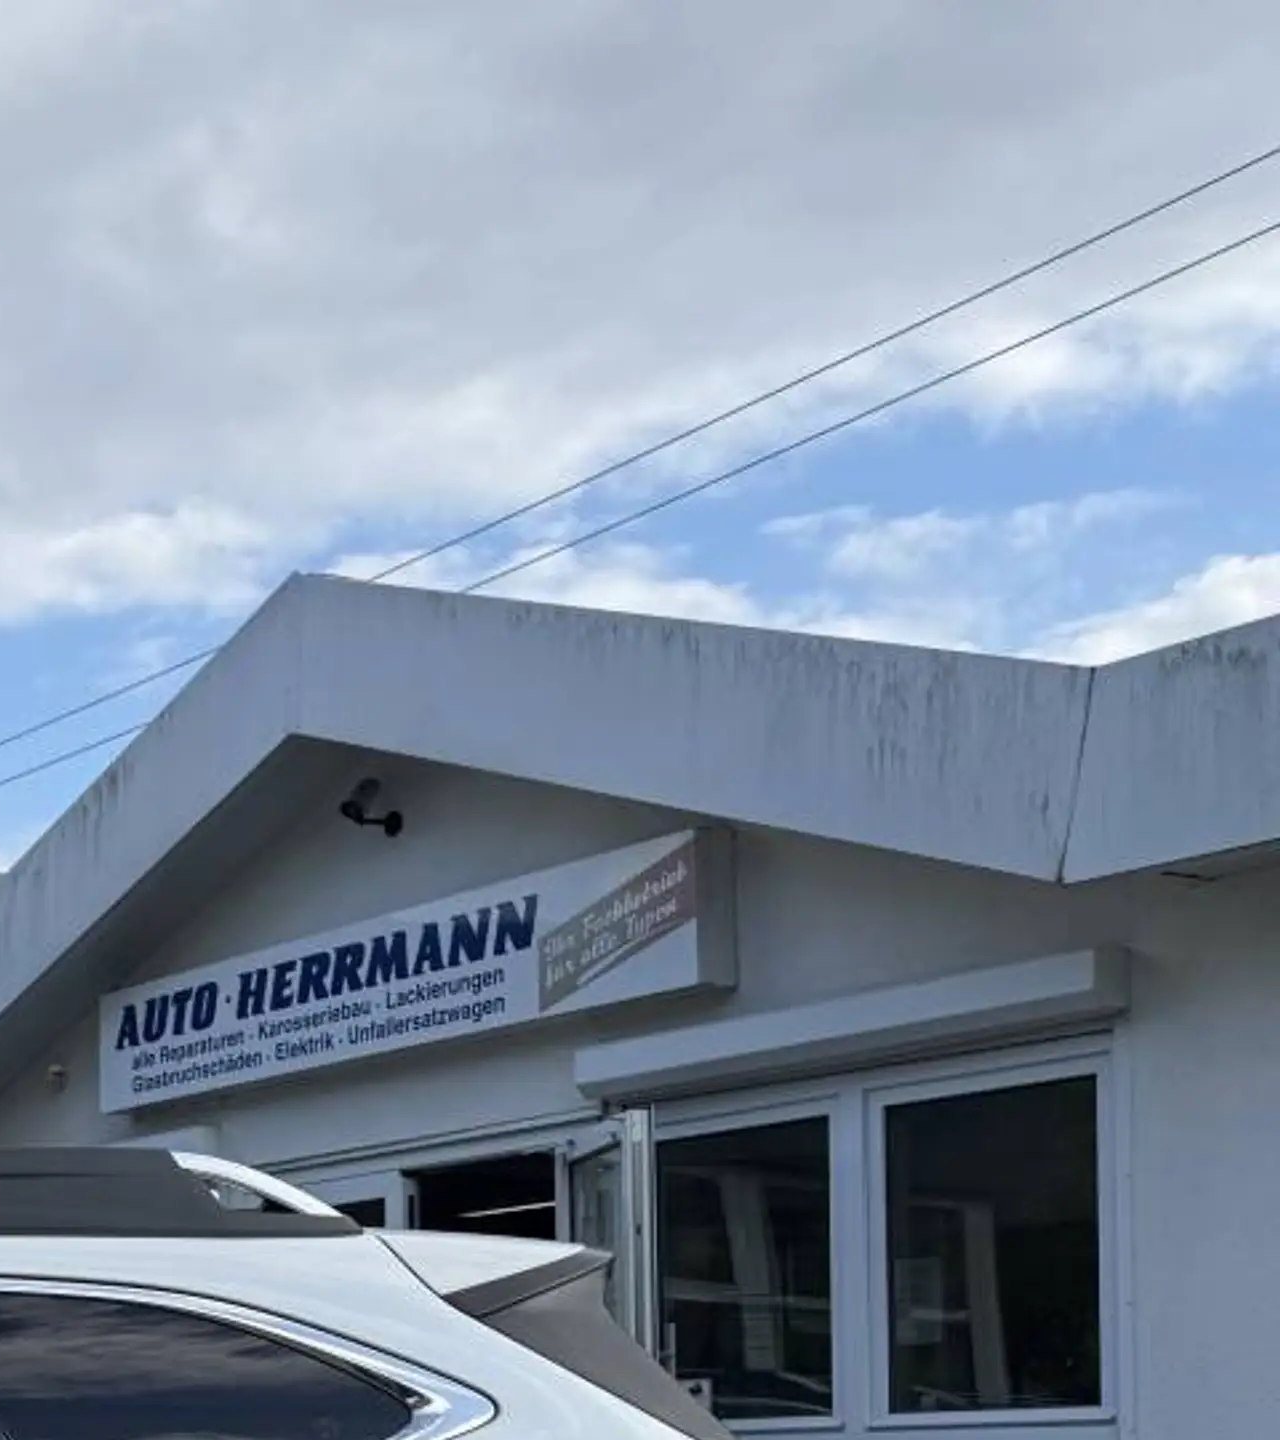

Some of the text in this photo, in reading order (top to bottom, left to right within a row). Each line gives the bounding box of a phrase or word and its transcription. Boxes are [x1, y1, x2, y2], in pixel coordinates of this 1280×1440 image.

[115, 893, 538, 1050] AUTO HERRMANN
[159, 1030, 245, 1066] Reparaturen
[257, 1000, 372, 1041] Karosseriebau
[385, 967, 505, 1010] Lackierungen
[274, 1031, 335, 1061] Elektrik
[346, 996, 506, 1046] Unfallersatzwagen
